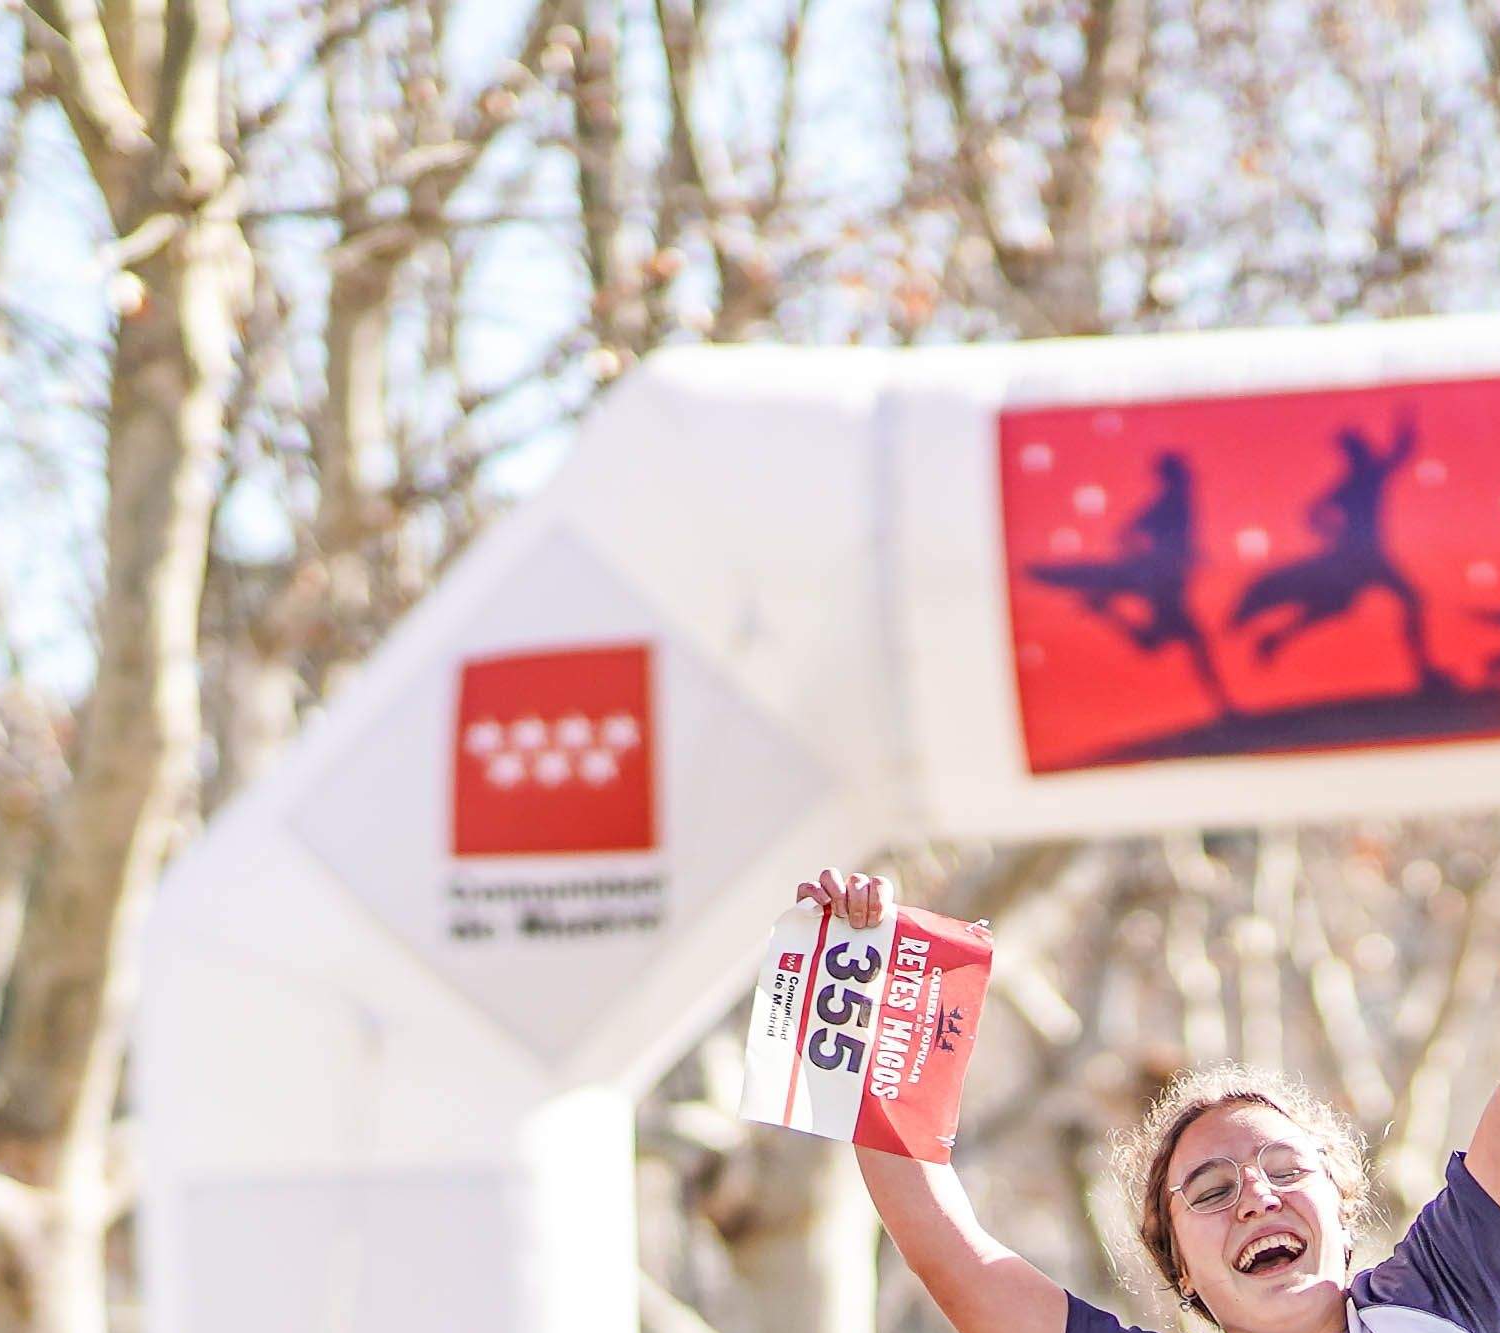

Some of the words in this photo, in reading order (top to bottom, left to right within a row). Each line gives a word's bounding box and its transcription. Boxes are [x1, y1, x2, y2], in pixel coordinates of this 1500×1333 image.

[774, 973, 786, 989] de
[808, 941, 882, 1074] 355
[887, 936, 931, 1011] REYES
[869, 1016, 913, 1100] MAGOS
